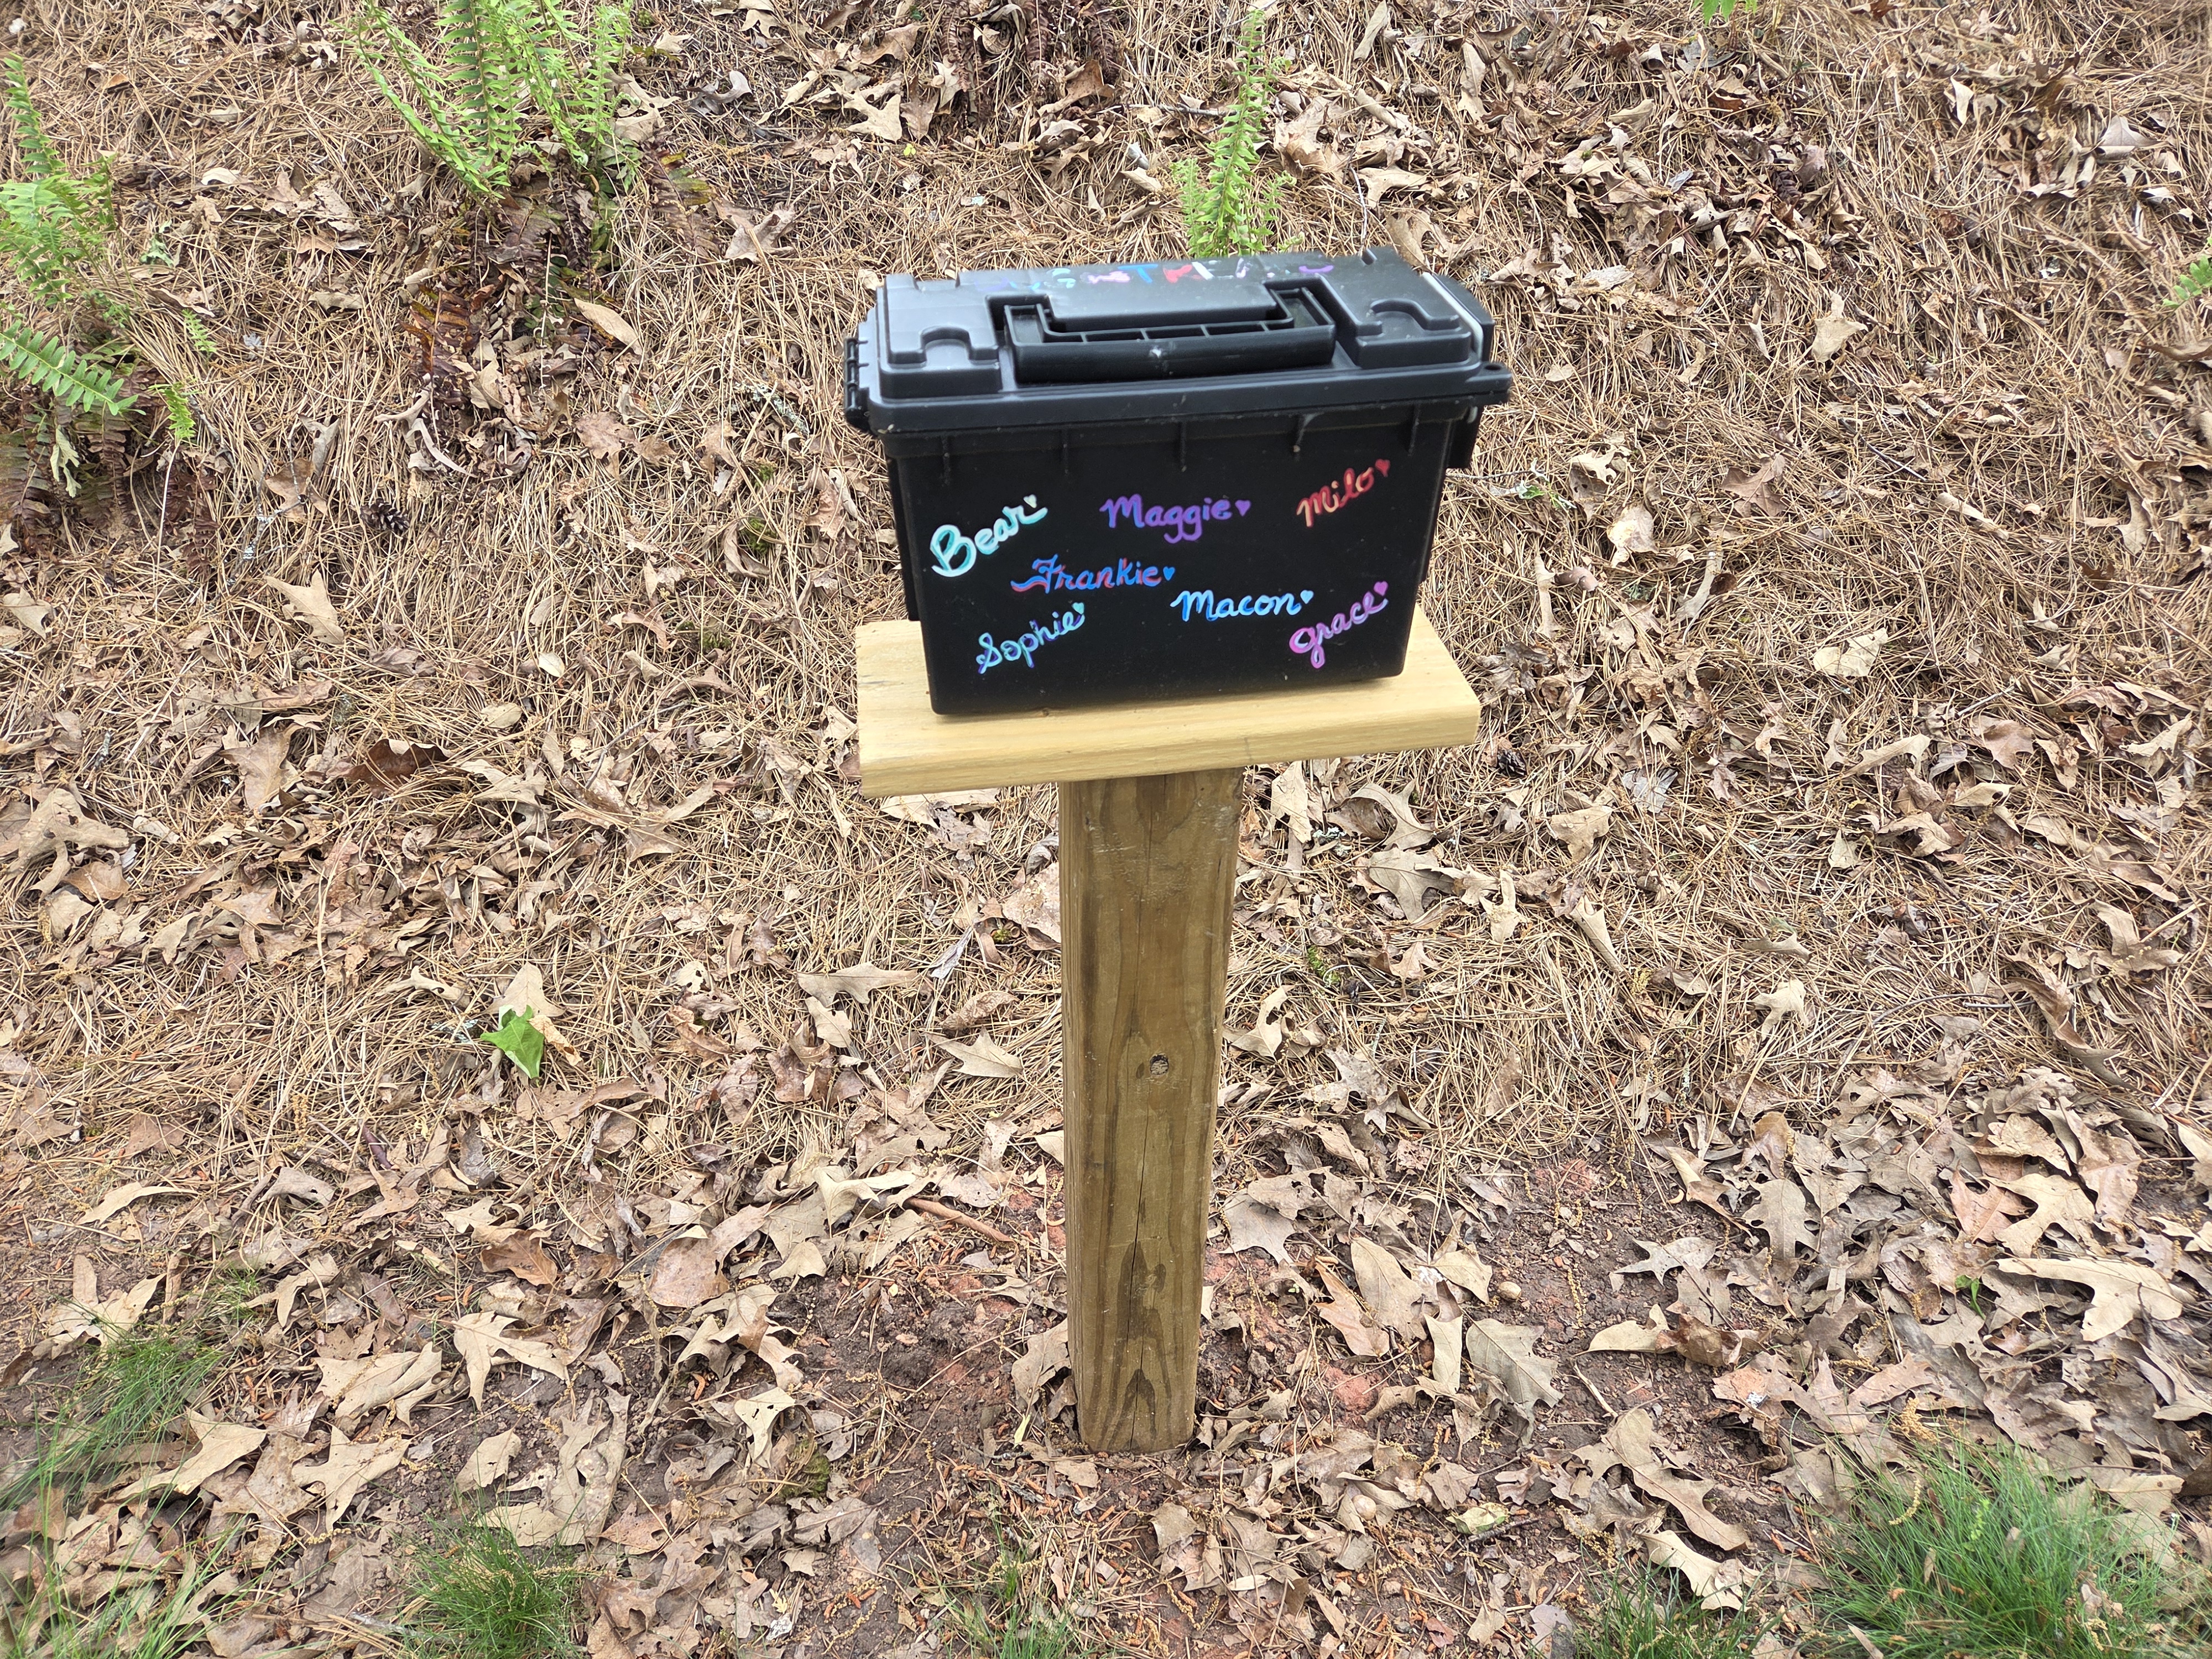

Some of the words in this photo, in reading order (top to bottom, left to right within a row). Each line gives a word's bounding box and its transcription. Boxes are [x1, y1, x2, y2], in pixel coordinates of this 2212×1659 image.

[1099, 493, 1233, 544] Maggie
[1296, 467, 1375, 528] Milo
[930, 505, 1048, 577] Bear
[1010, 553, 1162, 594] Frankie
[1170, 589, 1302, 622] Macon
[975, 611, 1086, 675] Sophie
